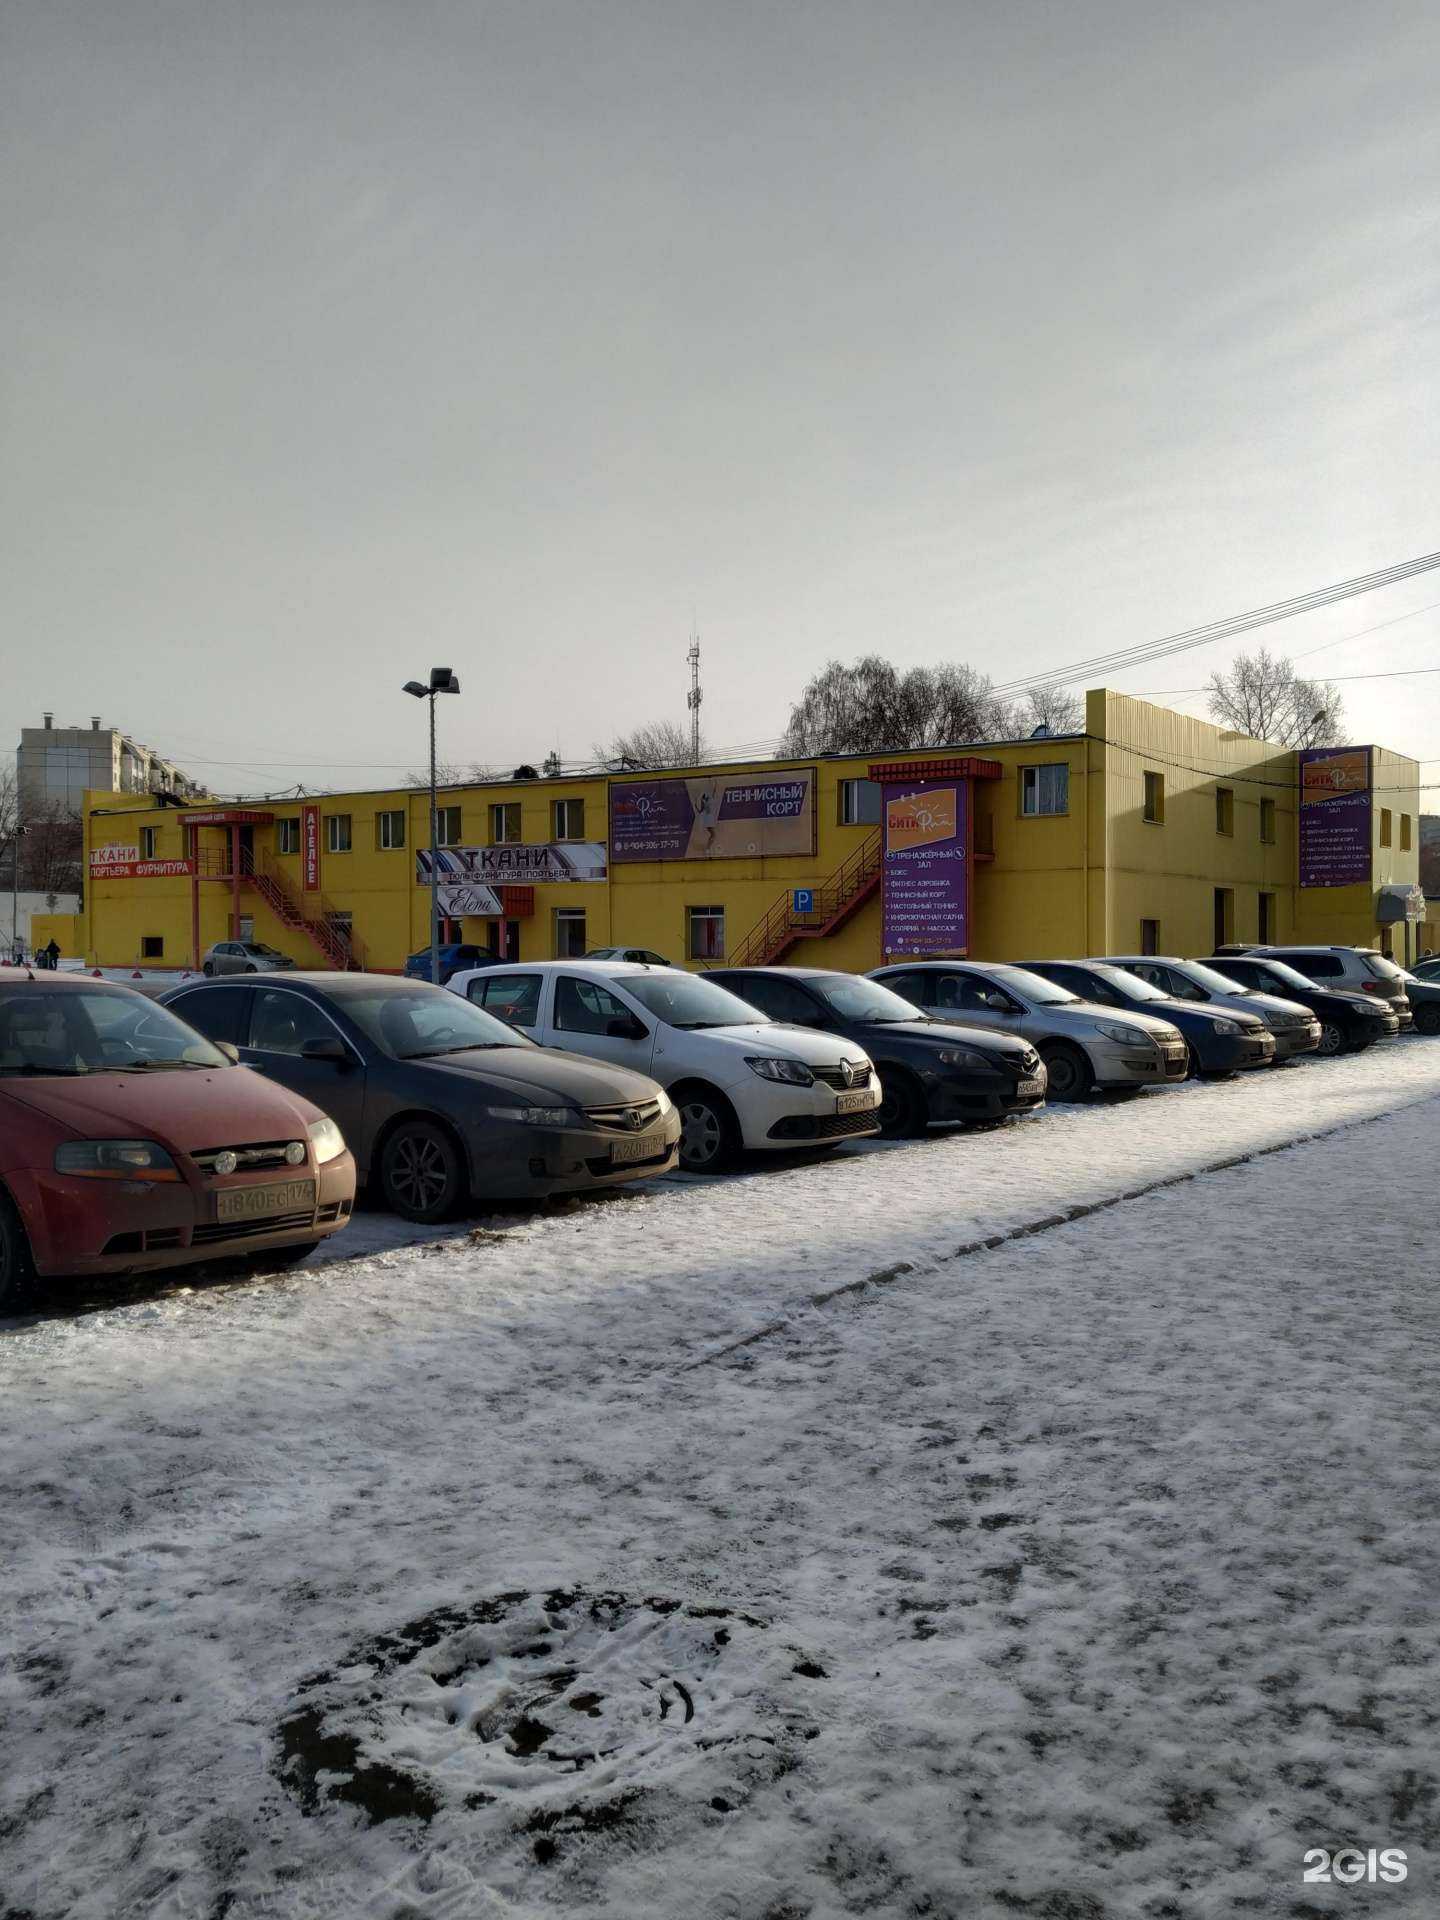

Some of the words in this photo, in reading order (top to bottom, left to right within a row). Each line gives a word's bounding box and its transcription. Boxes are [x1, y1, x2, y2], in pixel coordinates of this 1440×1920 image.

[725, 782, 803, 803] ТЕННИСНЫЙ
[767, 801, 801, 816] КОРТ
[90, 848, 137, 865] ТКАНИ
[307, 812, 317, 884] АТЕЛЬЕ
[465, 848, 549, 870] ТКАНИ
[90, 865, 130, 878] ПОРТЬЕРА
[136, 861, 190, 875] ФУРНИТУРА
[449, 872, 471, 881] ТЮЛЬ
[473, 870, 522, 881] ФУРНИТУРА
[526, 869, 570, 879] ПОРТЬЕРА
[445, 887, 492, 914] Elena
